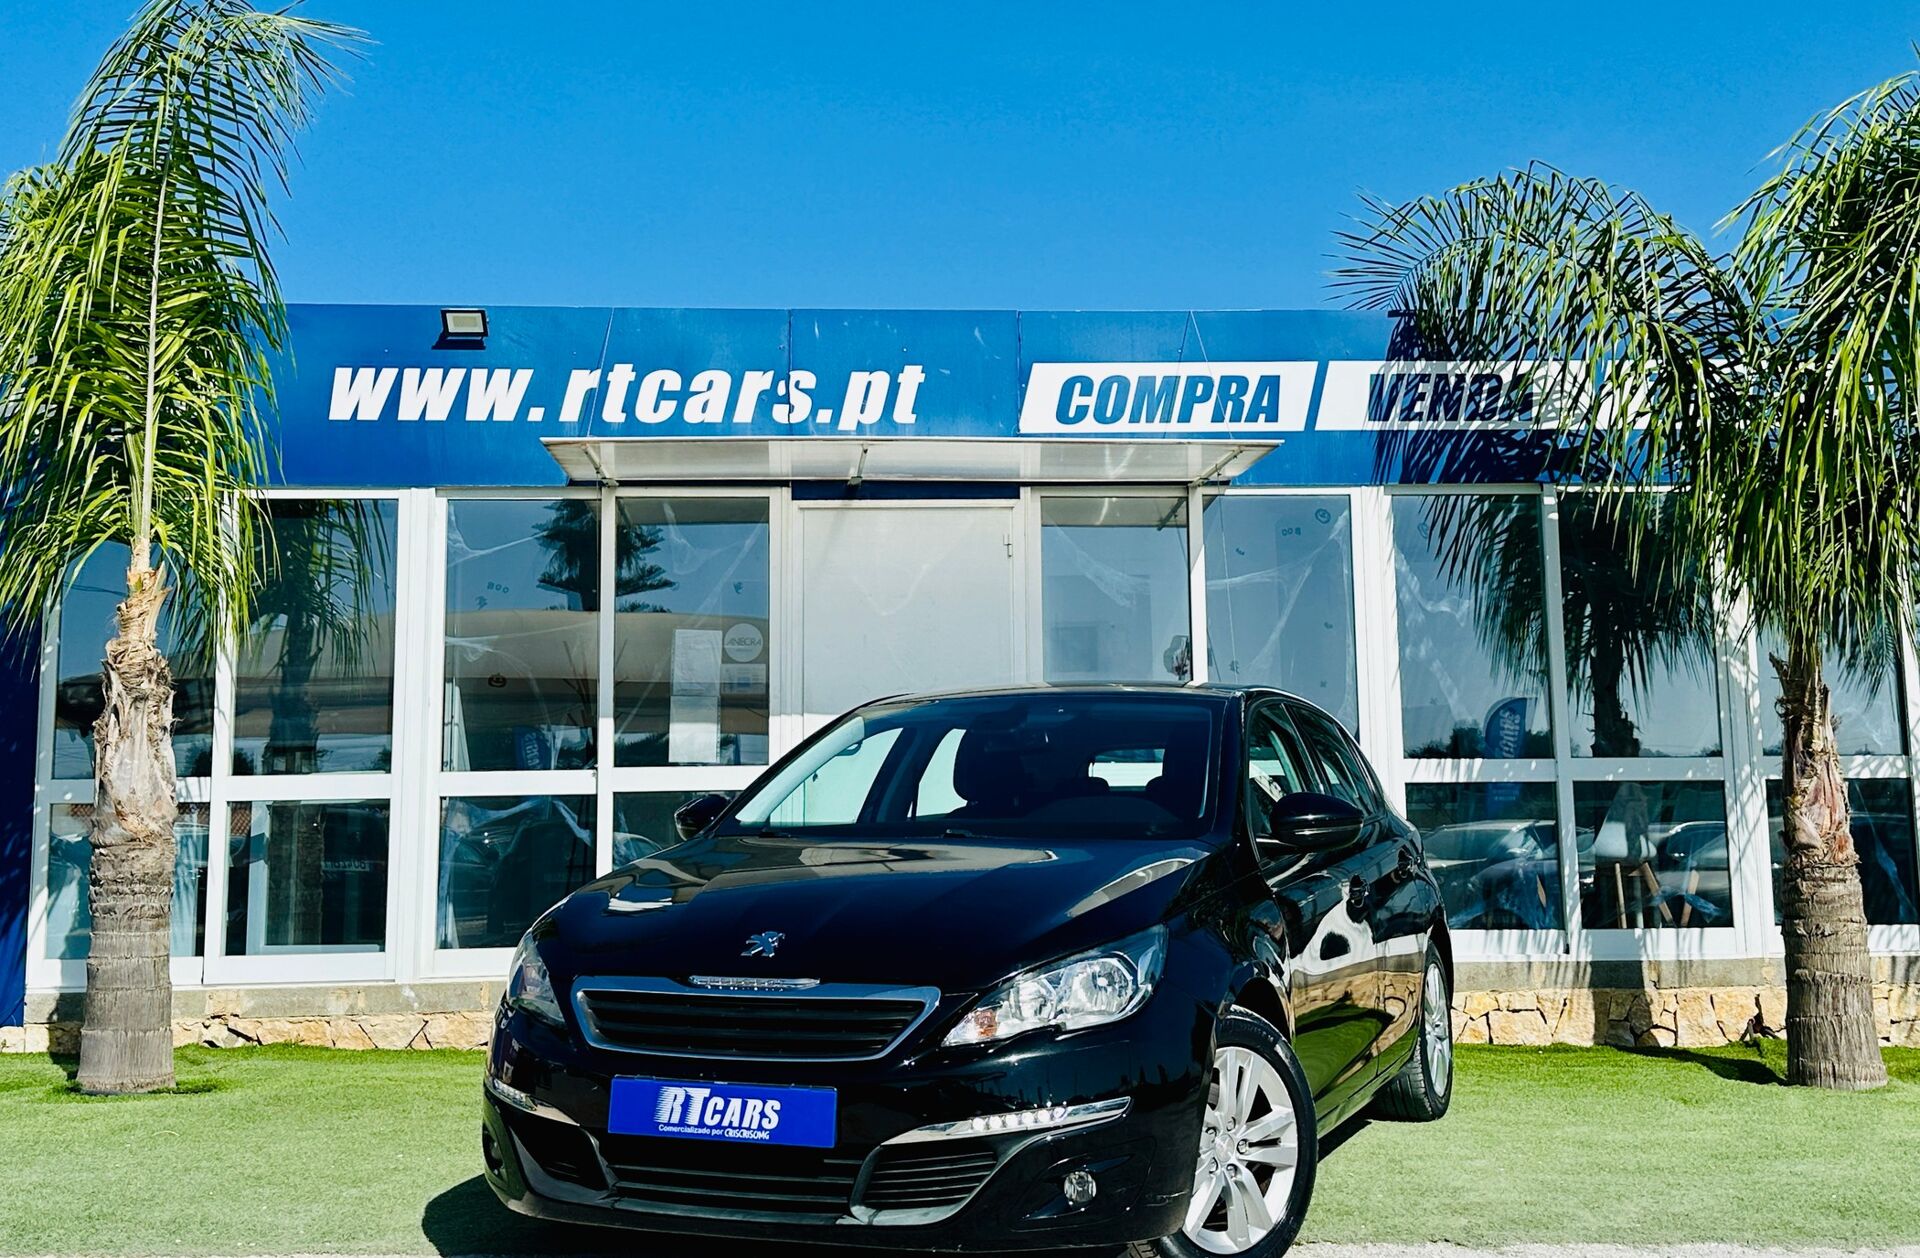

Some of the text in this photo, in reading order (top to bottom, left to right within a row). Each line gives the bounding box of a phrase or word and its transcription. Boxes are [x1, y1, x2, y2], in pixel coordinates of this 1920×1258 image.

[329, 363, 926, 432] www.rtcars.pt
[1056, 374, 1280, 425] COMPRA
[658, 1124, 711, 1135] Comercializado
[711, 1128, 724, 1137] por
